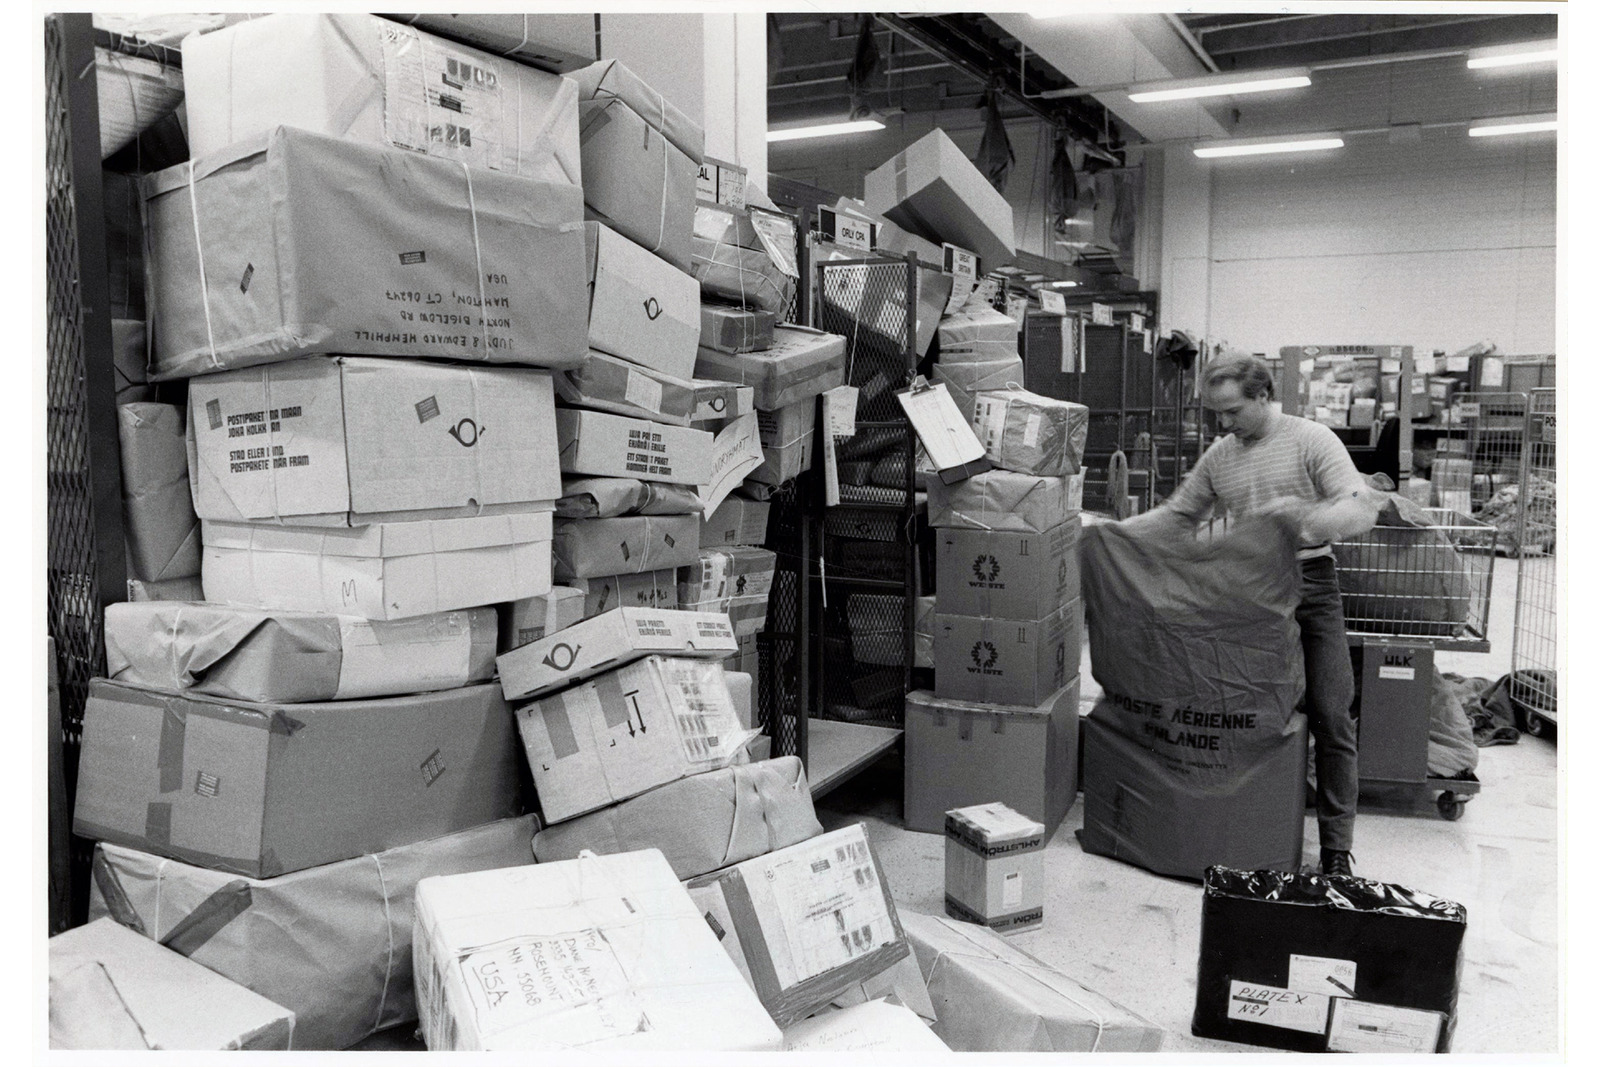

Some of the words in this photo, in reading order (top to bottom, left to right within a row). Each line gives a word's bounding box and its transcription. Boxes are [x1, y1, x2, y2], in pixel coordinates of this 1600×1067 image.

[841, 227, 855, 240] ORLY
[855, 230, 866, 242] CPA
[486, 273, 508, 284] USA
[386, 289, 421, 302] 06247
[425, 293, 442, 304] CT
[400, 310, 414, 321] RD
[419, 312, 471, 326] BIGELOW
[478, 318, 511, 328] NORTH
[354, 331, 417, 343] HEMPHILL
[424, 336, 466, 347] EDWARD
[473, 336, 480, 347] &
[281, 405, 302, 419] MAAN
[228, 426, 245, 438] JOKA
[246, 421, 281, 436] KOLKKAN
[229, 449, 245, 462] STAD
[247, 447, 265, 459] ELLER
[289, 455, 310, 467] FRAM
[626, 452, 635, 461] ETT
[654, 456, 669, 466] PAKET
[626, 462, 648, 473] KOMMER
[659, 465, 672, 476] FRAM
[342, 578, 357, 607] M
[1113, 692, 1163, 719] POSTE
[1170, 705, 1257, 729] AÉRIENNE
[529, 941, 565, 1001] ROSEMOUNT
[480, 961, 509, 1007] USA
[517, 972, 542, 1006] 55068
[1238, 986, 1308, 1005] PLATEX
